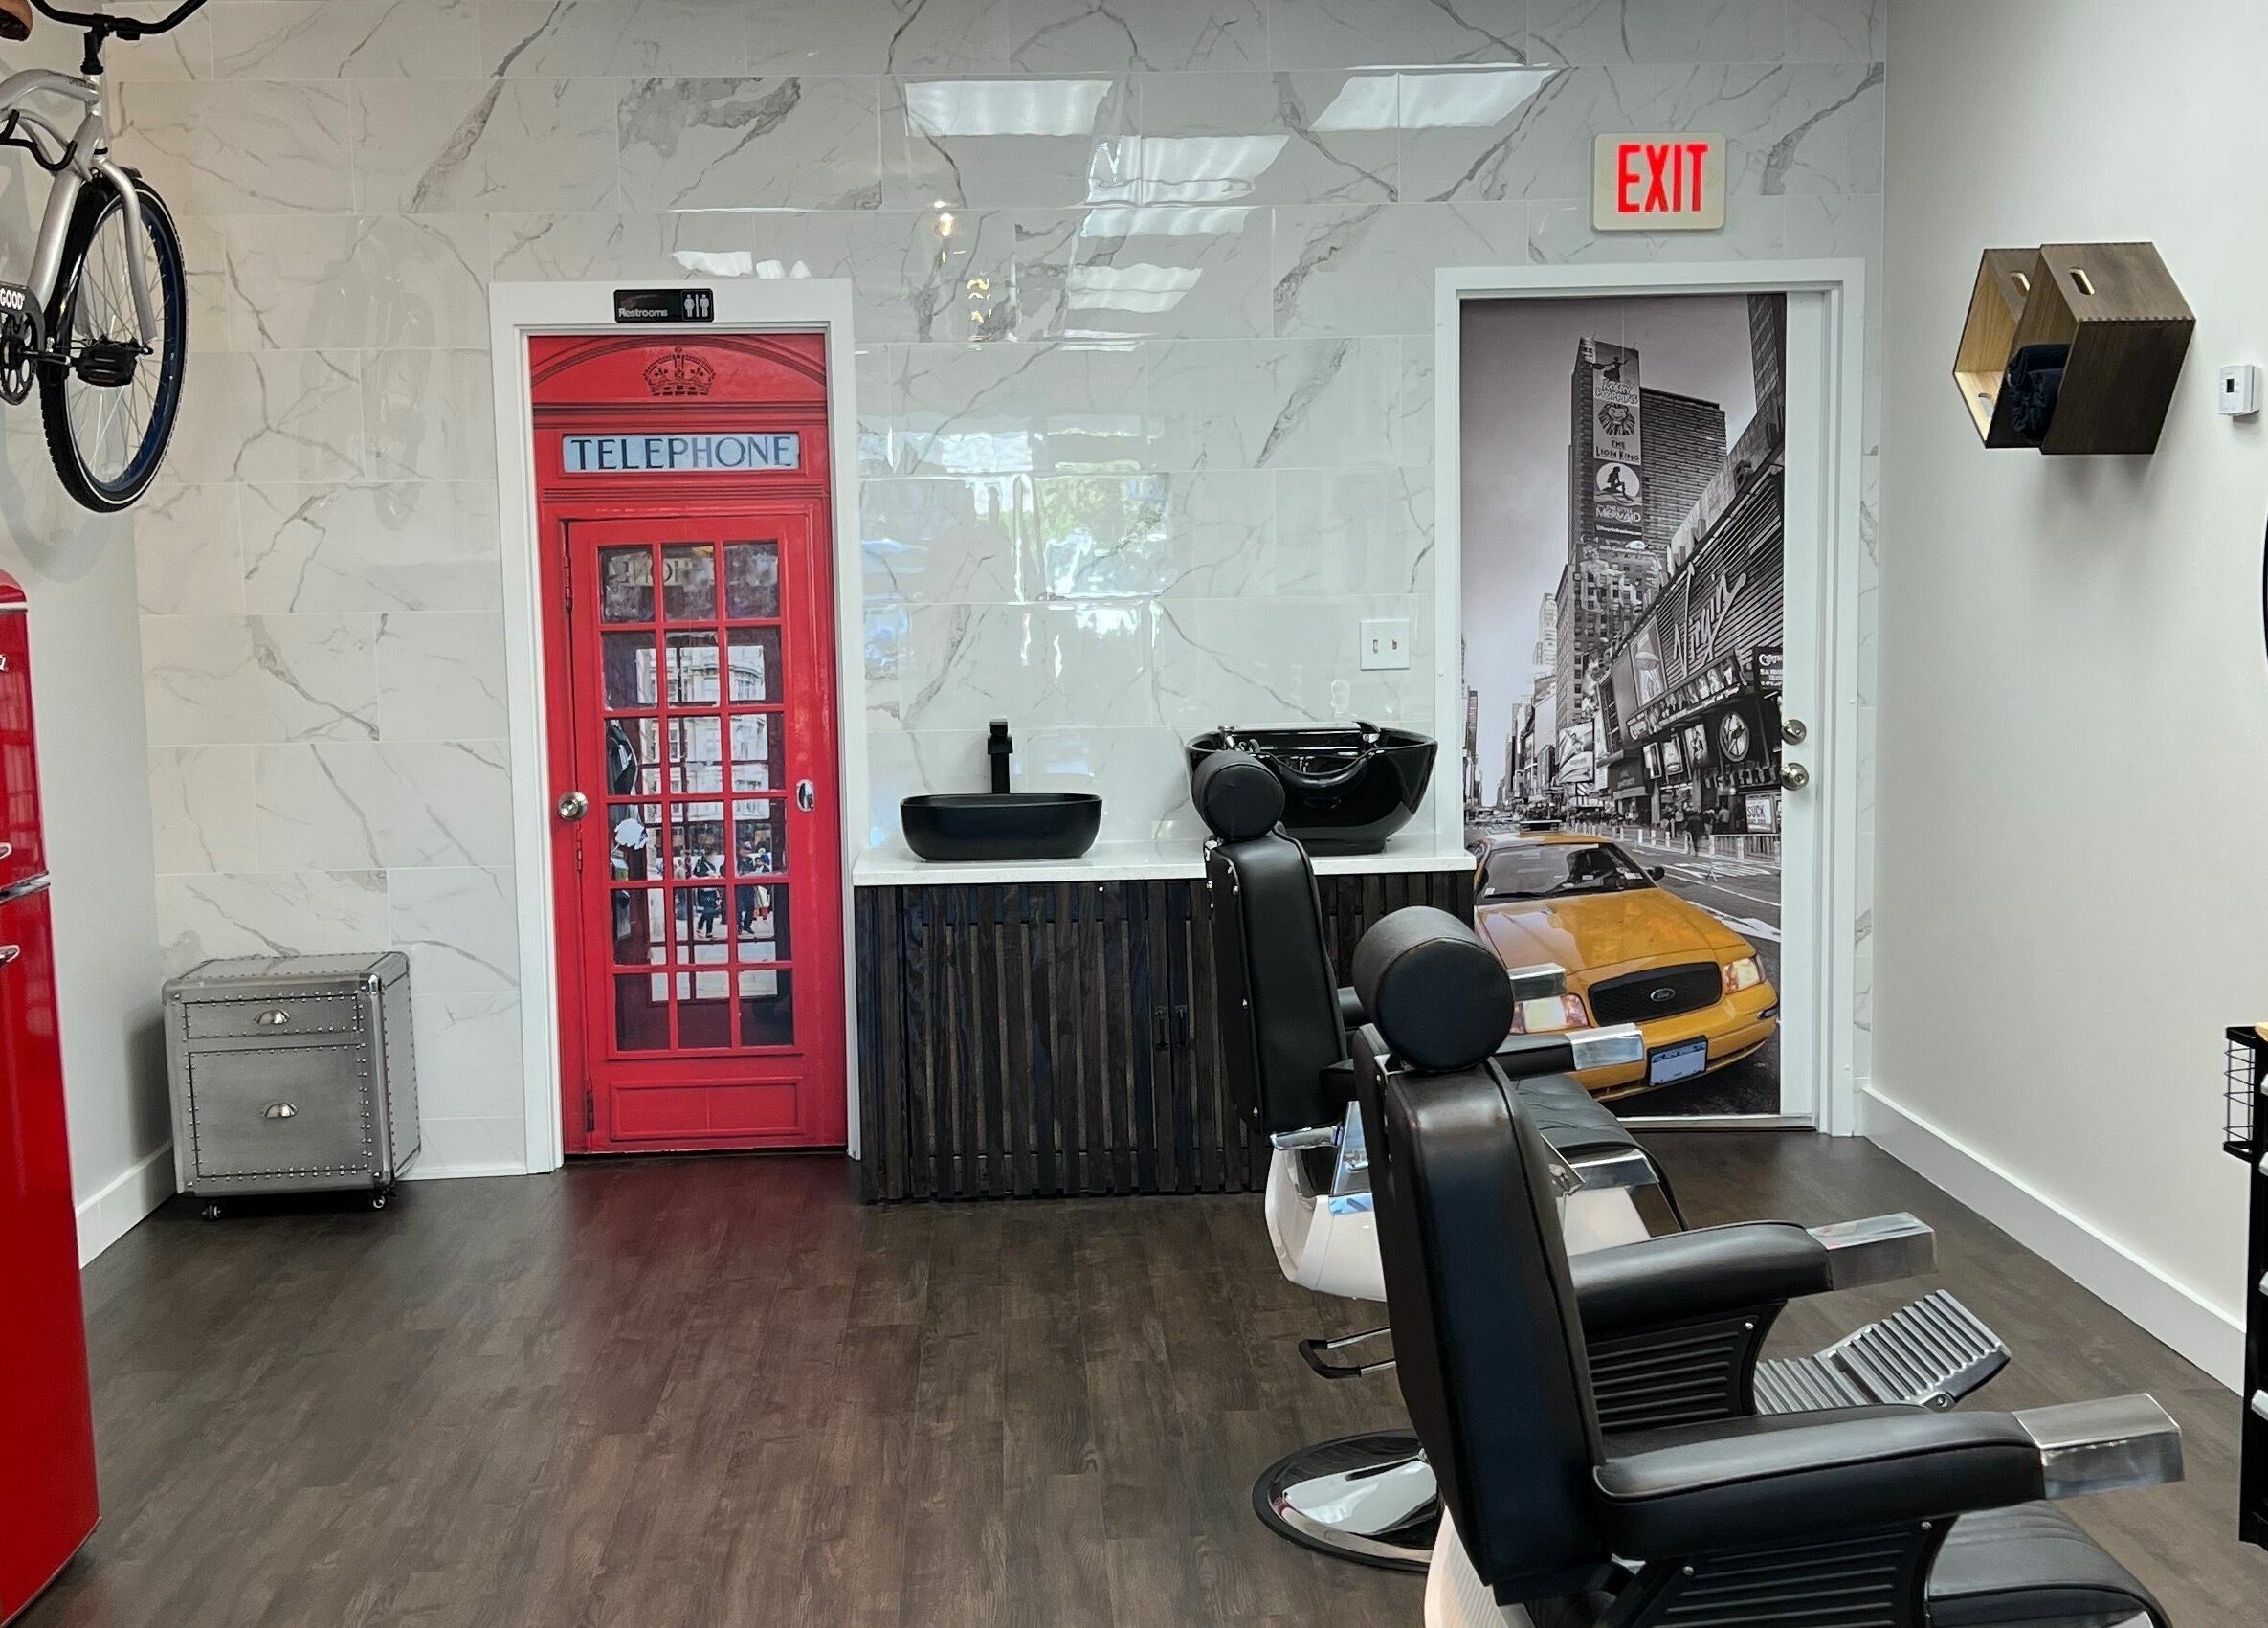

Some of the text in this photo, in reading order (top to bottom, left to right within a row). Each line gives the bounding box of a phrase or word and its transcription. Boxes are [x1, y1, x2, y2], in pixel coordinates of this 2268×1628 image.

[1617, 144, 1709, 213] EXIT
[618, 307, 668, 318] Restrooms
[570, 436, 792, 470] TELEPHONE
